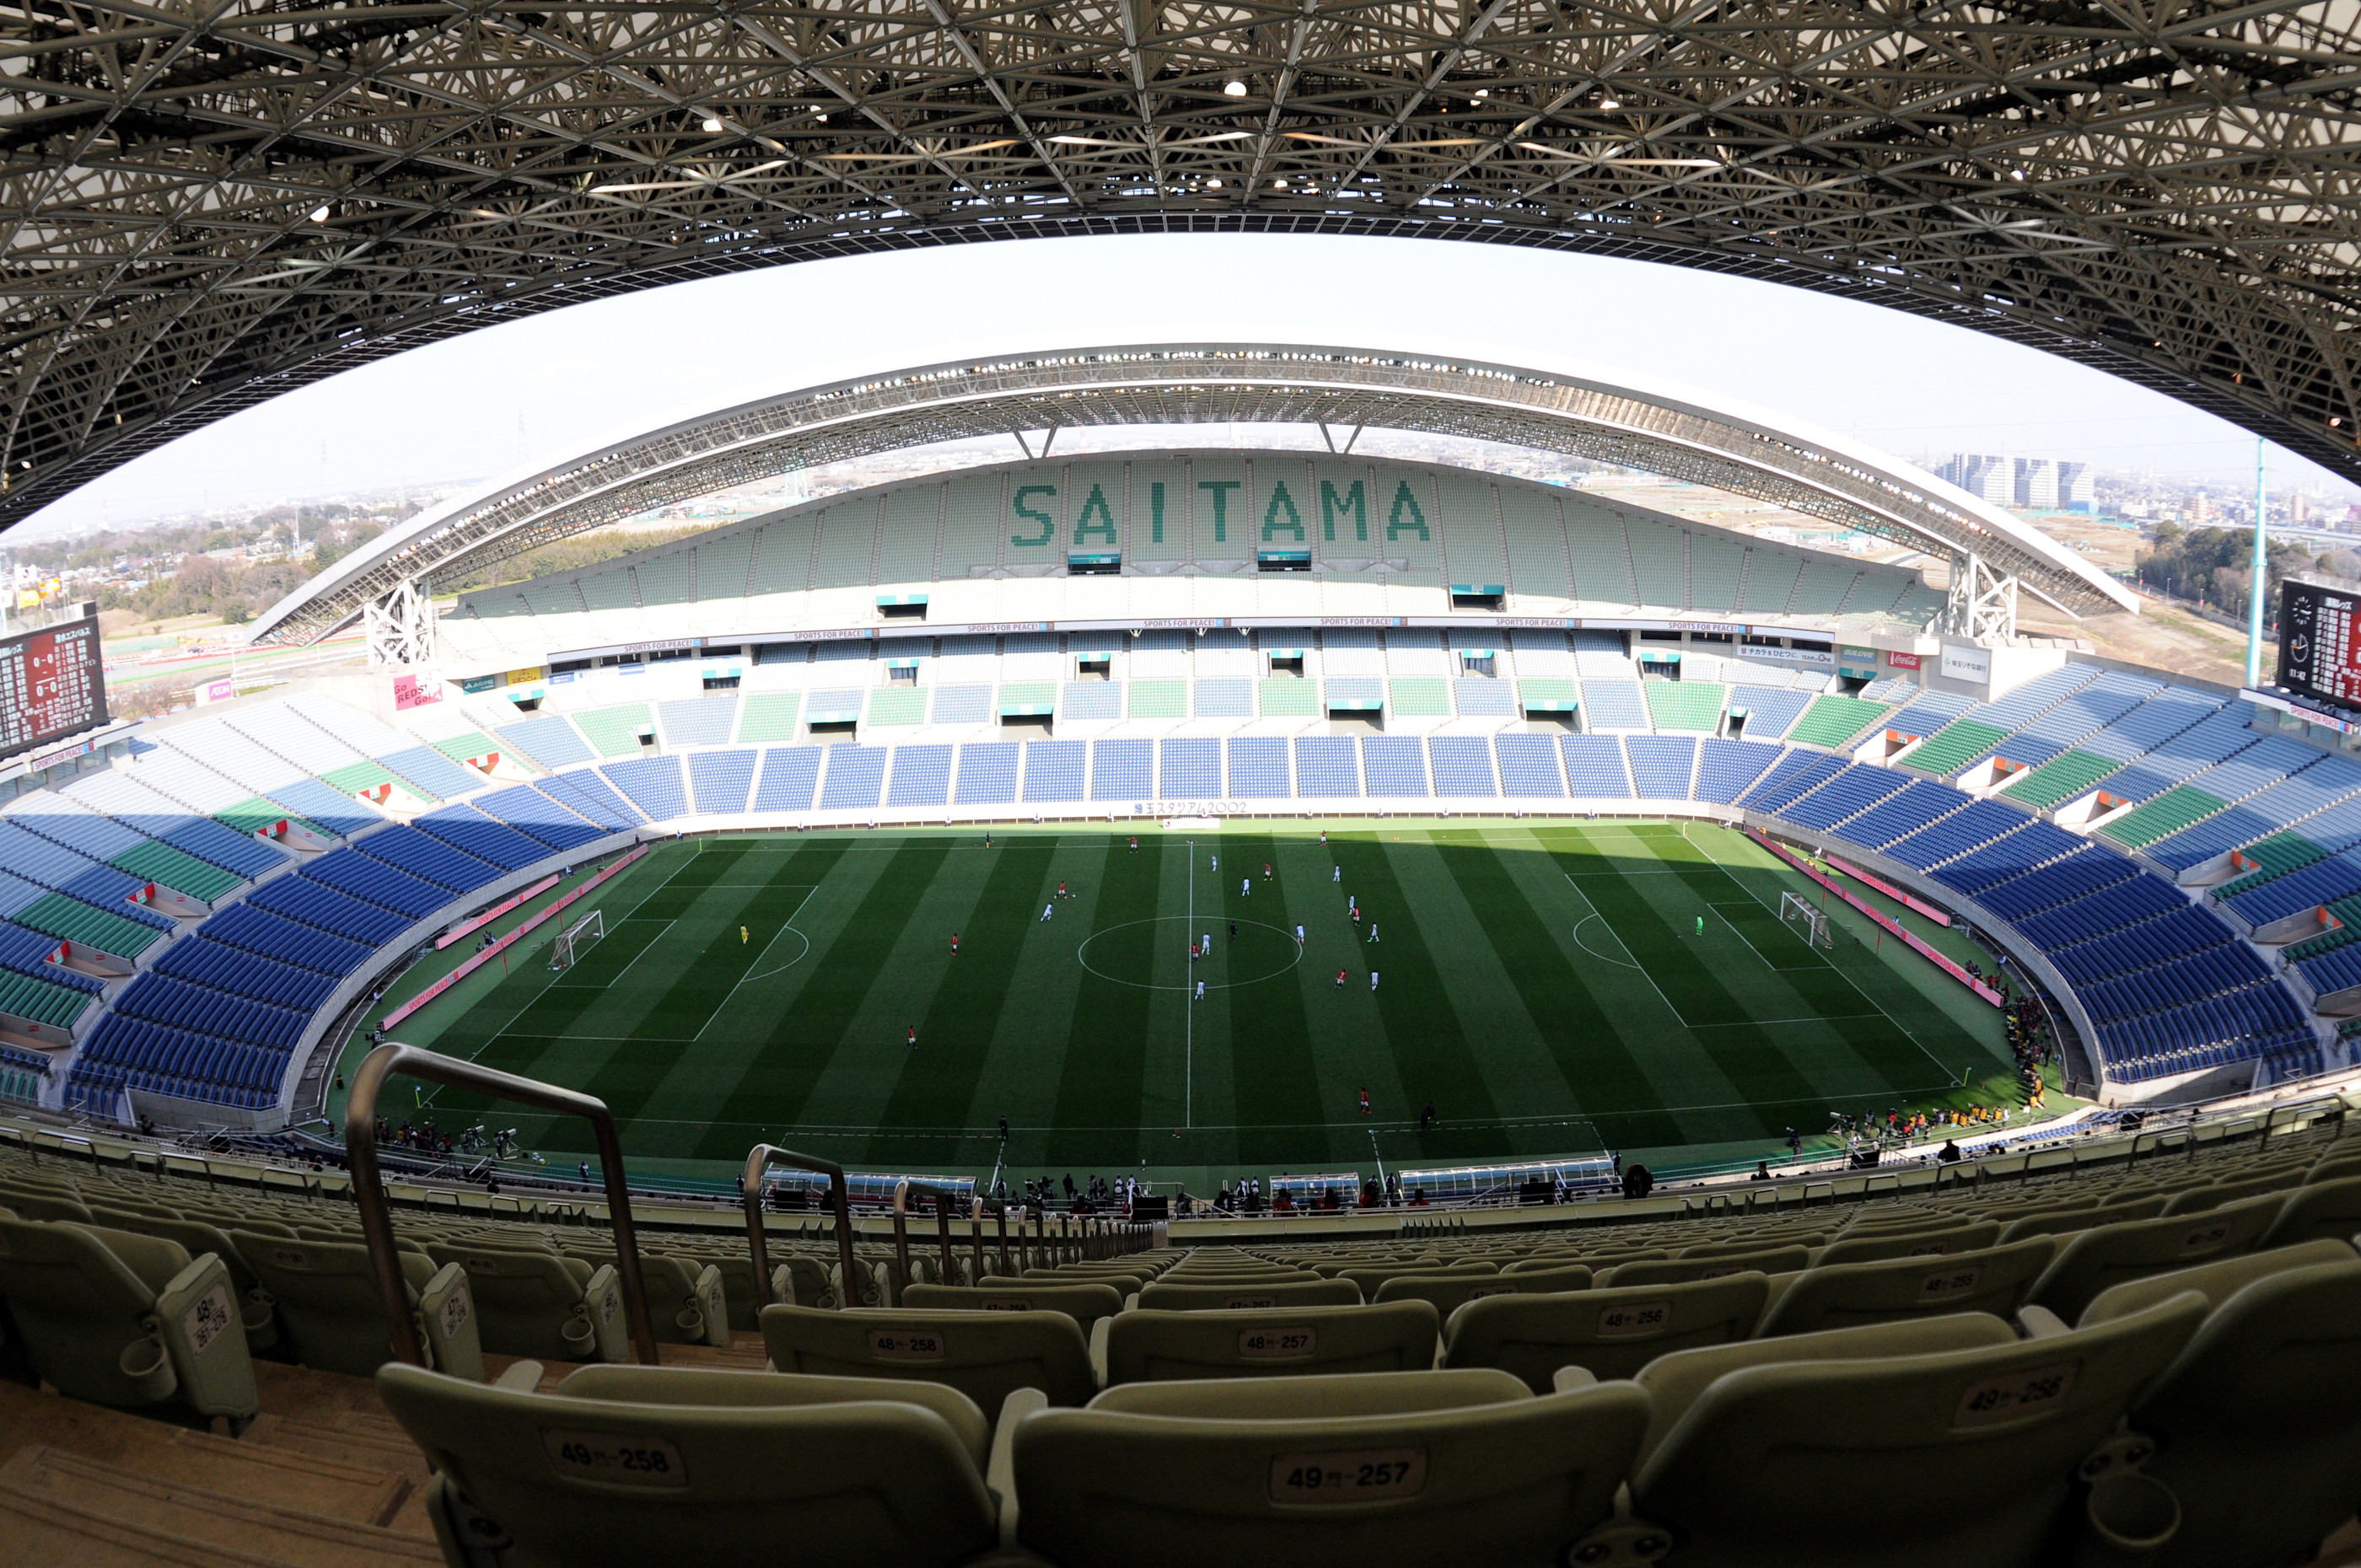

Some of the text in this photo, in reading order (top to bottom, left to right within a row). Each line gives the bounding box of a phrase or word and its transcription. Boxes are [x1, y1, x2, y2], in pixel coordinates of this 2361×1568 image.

[1011, 480, 1430, 547] SAITAMA
[967, 624, 996, 632] SPORTS
[1143, 620, 1171, 628] SPORTS
[1668, 621, 1696, 630] SPORTS
[1712, 624, 1737, 632] PEACE!
[794, 630, 863, 640] SPORTS FOR PEACE!
[625, 640, 692, 652] SPORTS FOR PEACE!
[1894, 654, 1918, 666] Coca-Cola
[211, 685, 230, 696] AEON
[2290, 706, 2339, 729] SPORTS FOR PEACE!
[35, 747, 83, 770] SPORTS FOR PEACE!
[478, 911, 494, 926] SPORTS
[409, 994, 426, 1012] SPORTS
[426, 988, 435, 1000] FOR
